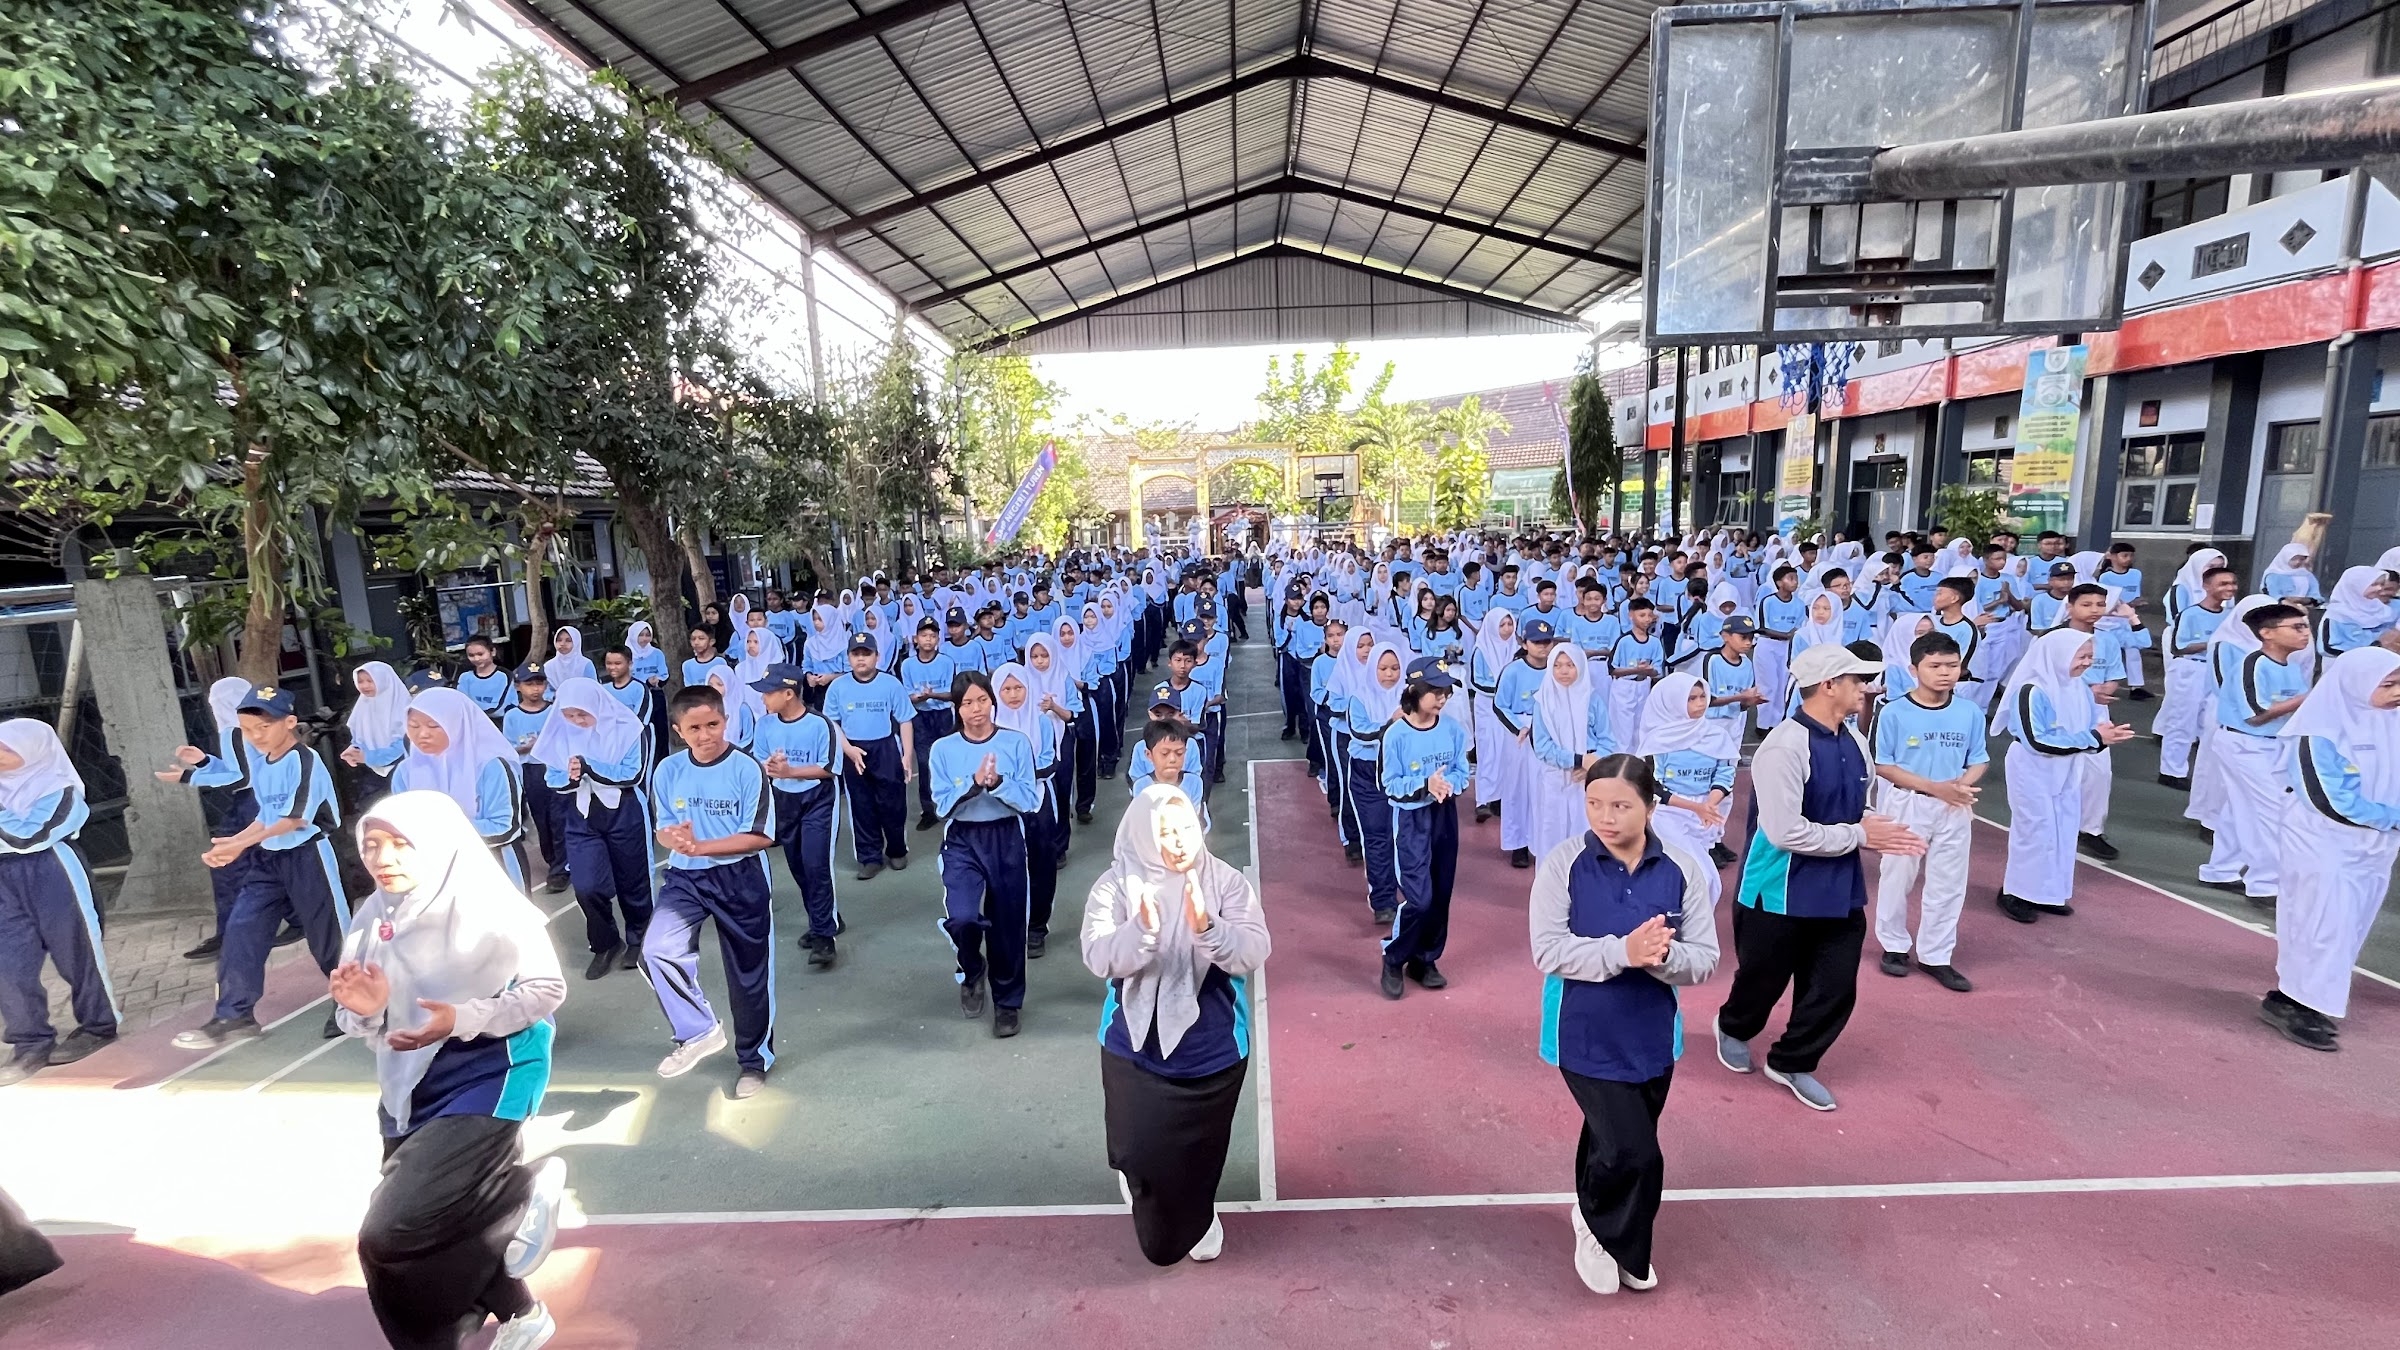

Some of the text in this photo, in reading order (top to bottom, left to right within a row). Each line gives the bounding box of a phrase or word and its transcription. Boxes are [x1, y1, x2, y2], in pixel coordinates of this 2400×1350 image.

[1005, 495, 1027, 523] NEGERI
[1025, 465, 1045, 491] TUREN
[806, 750, 810, 763] 1
[1677, 769, 1692, 777] SMP
[687, 797, 740, 817] SMP NEGERI 1
[704, 809, 733, 817] TUREN
